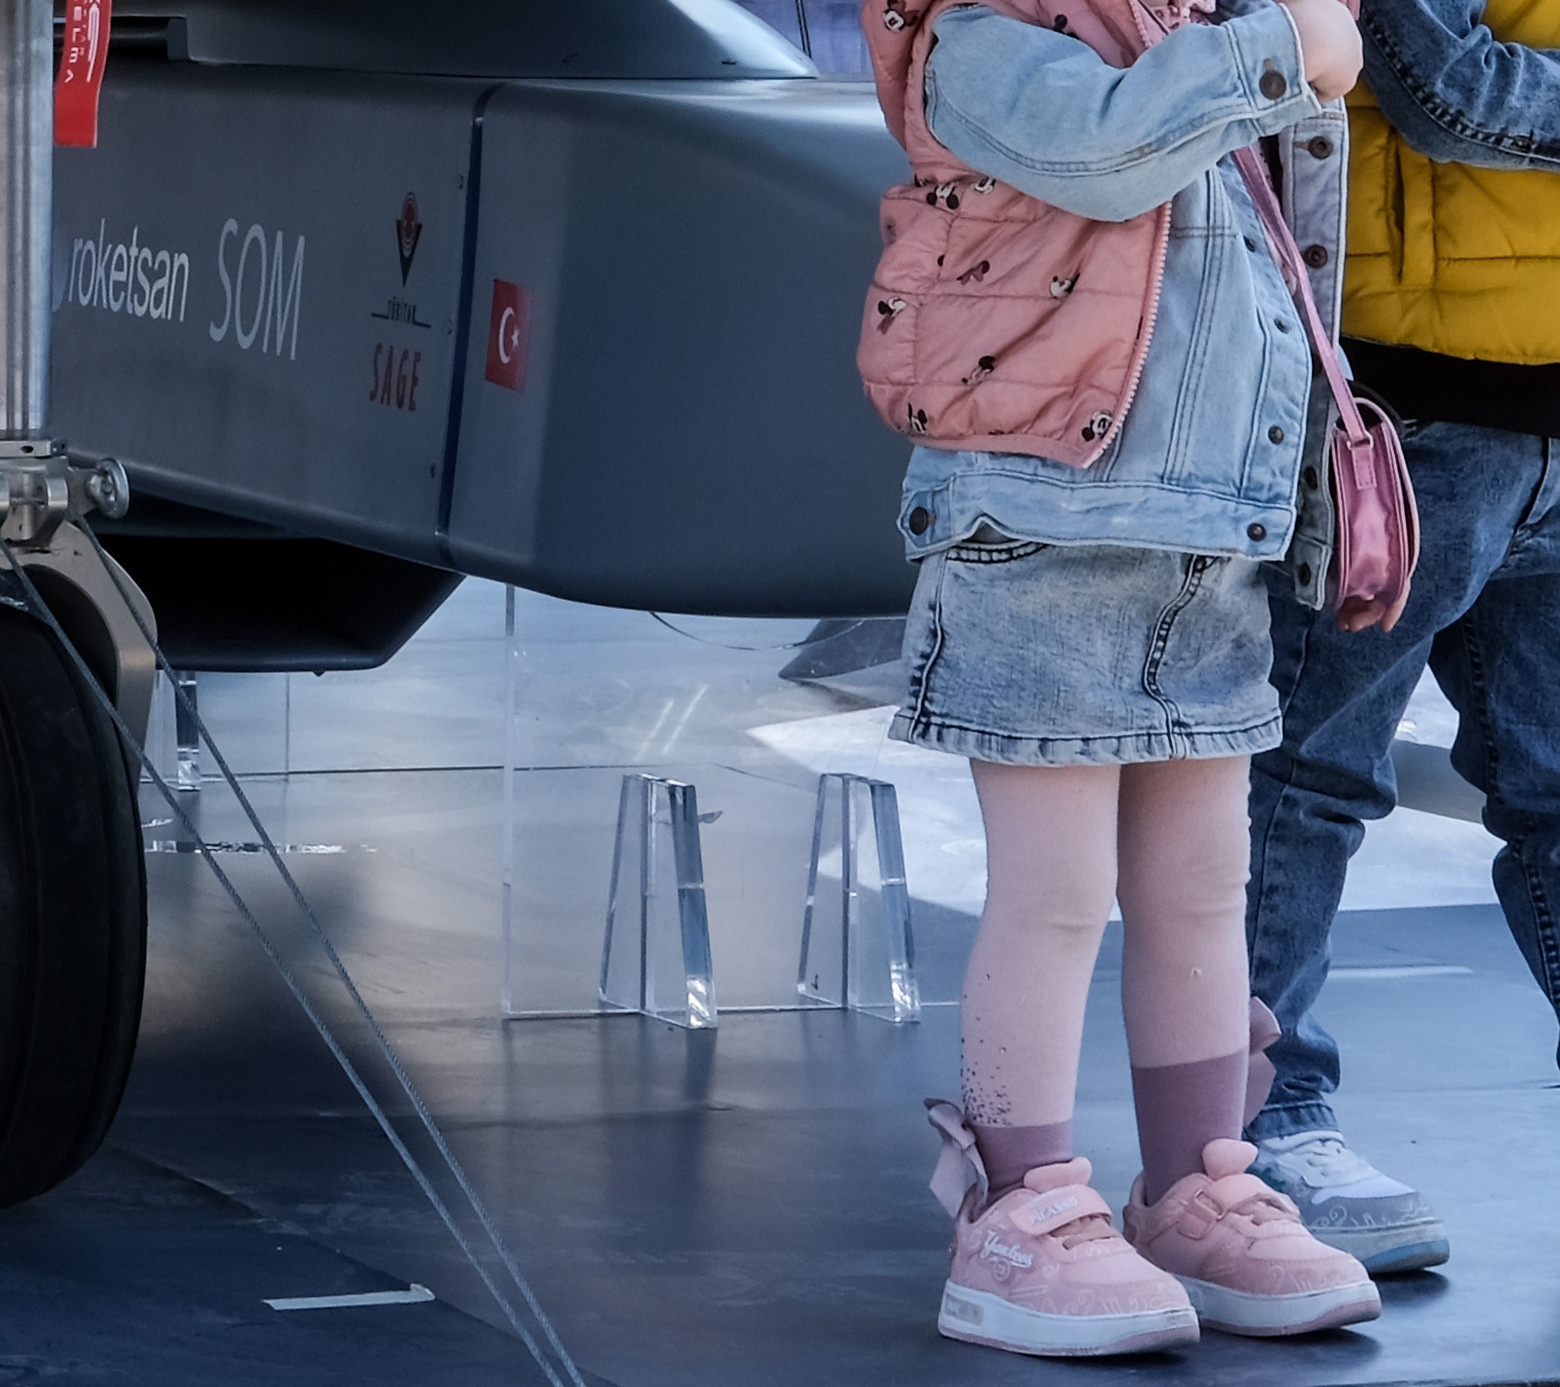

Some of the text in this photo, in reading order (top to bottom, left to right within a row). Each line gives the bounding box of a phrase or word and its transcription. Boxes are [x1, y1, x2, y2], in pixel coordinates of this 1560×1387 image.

[68, 217, 305, 361] roketsan SOM
[368, 342, 422, 411] SAGE
